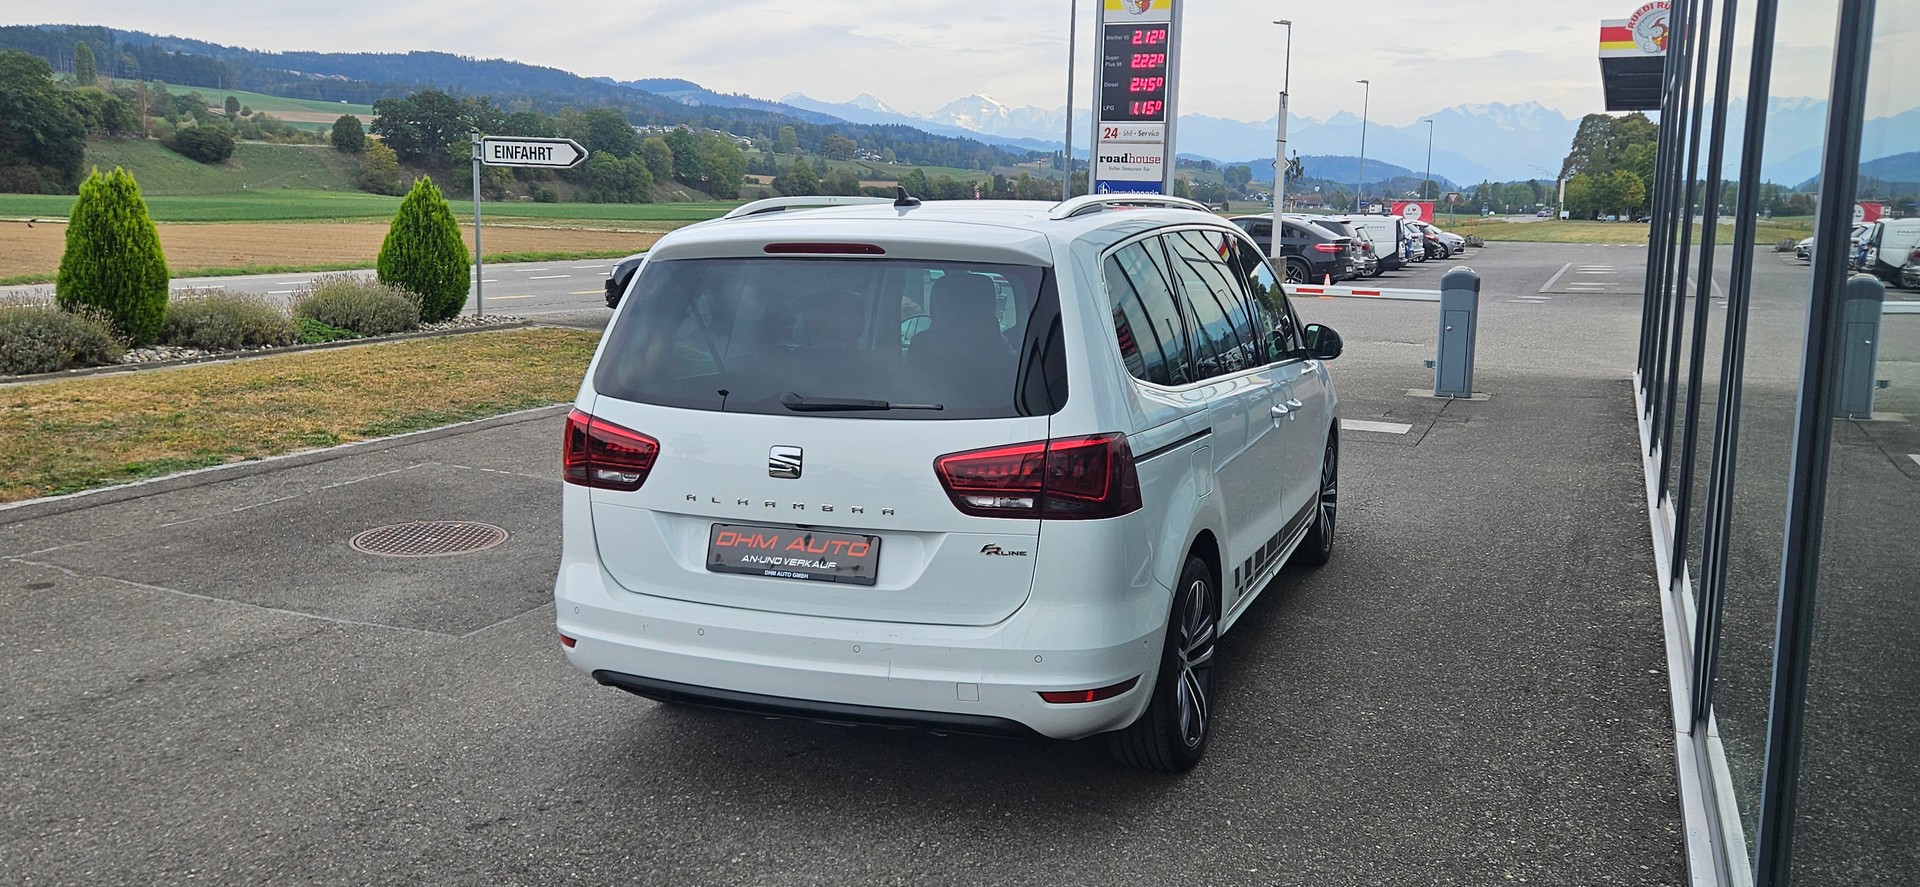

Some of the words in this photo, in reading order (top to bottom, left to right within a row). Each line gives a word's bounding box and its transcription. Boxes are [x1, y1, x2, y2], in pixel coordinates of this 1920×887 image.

[1627, 3, 1654, 29] RUEDI
[1104, 127, 1118, 139] 24
[1138, 129, 1160, 137] Service
[494, 145, 553, 161] EINFAHRT
[1099, 153, 1161, 164] roadhouse
[686, 493, 895, 516] ALHAMBRA
[715, 531, 779, 550] DHM
[785, 536, 871, 558] AUTO
[784, 557, 837, 570] VERKAUF
